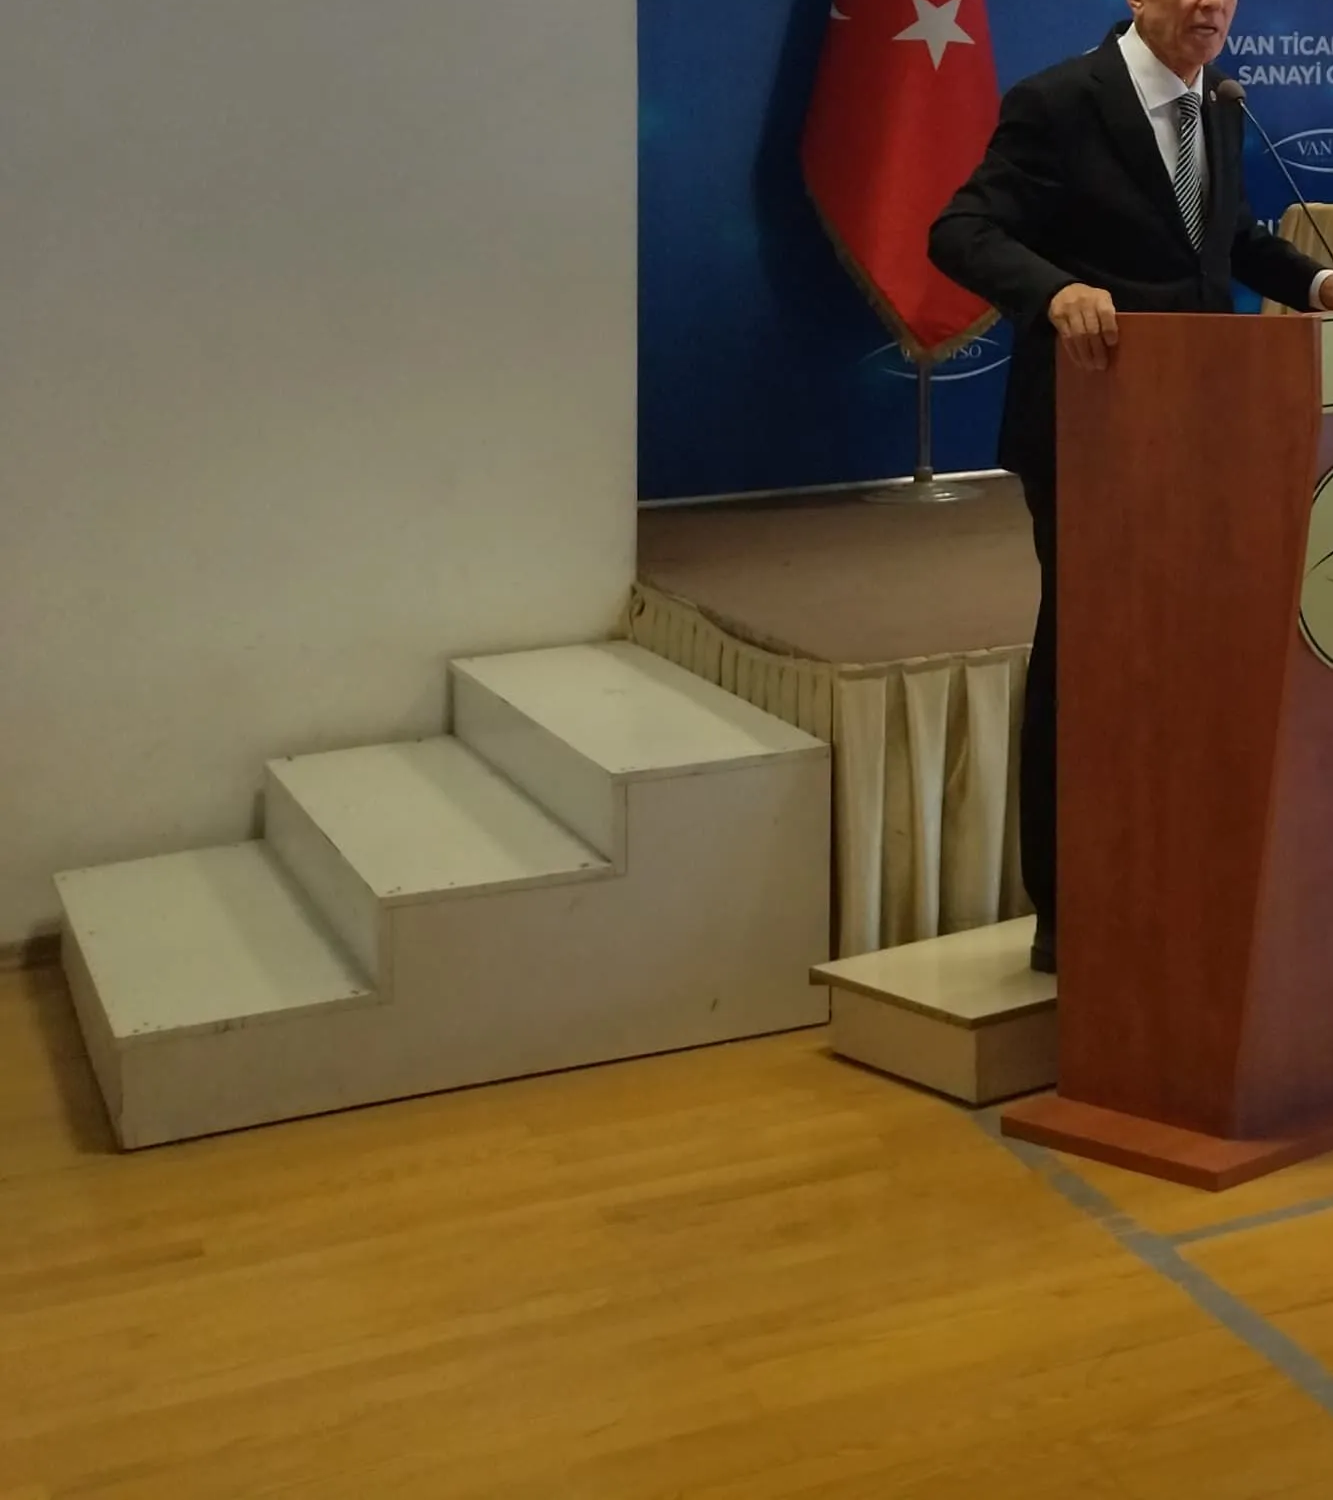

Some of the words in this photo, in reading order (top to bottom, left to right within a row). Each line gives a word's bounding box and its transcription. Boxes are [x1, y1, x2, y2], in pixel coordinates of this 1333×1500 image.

[1227, 36, 1275, 55] VAN
[1237, 61, 1322, 85] SANAYİ
[1296, 139, 1332, 156] VAN
